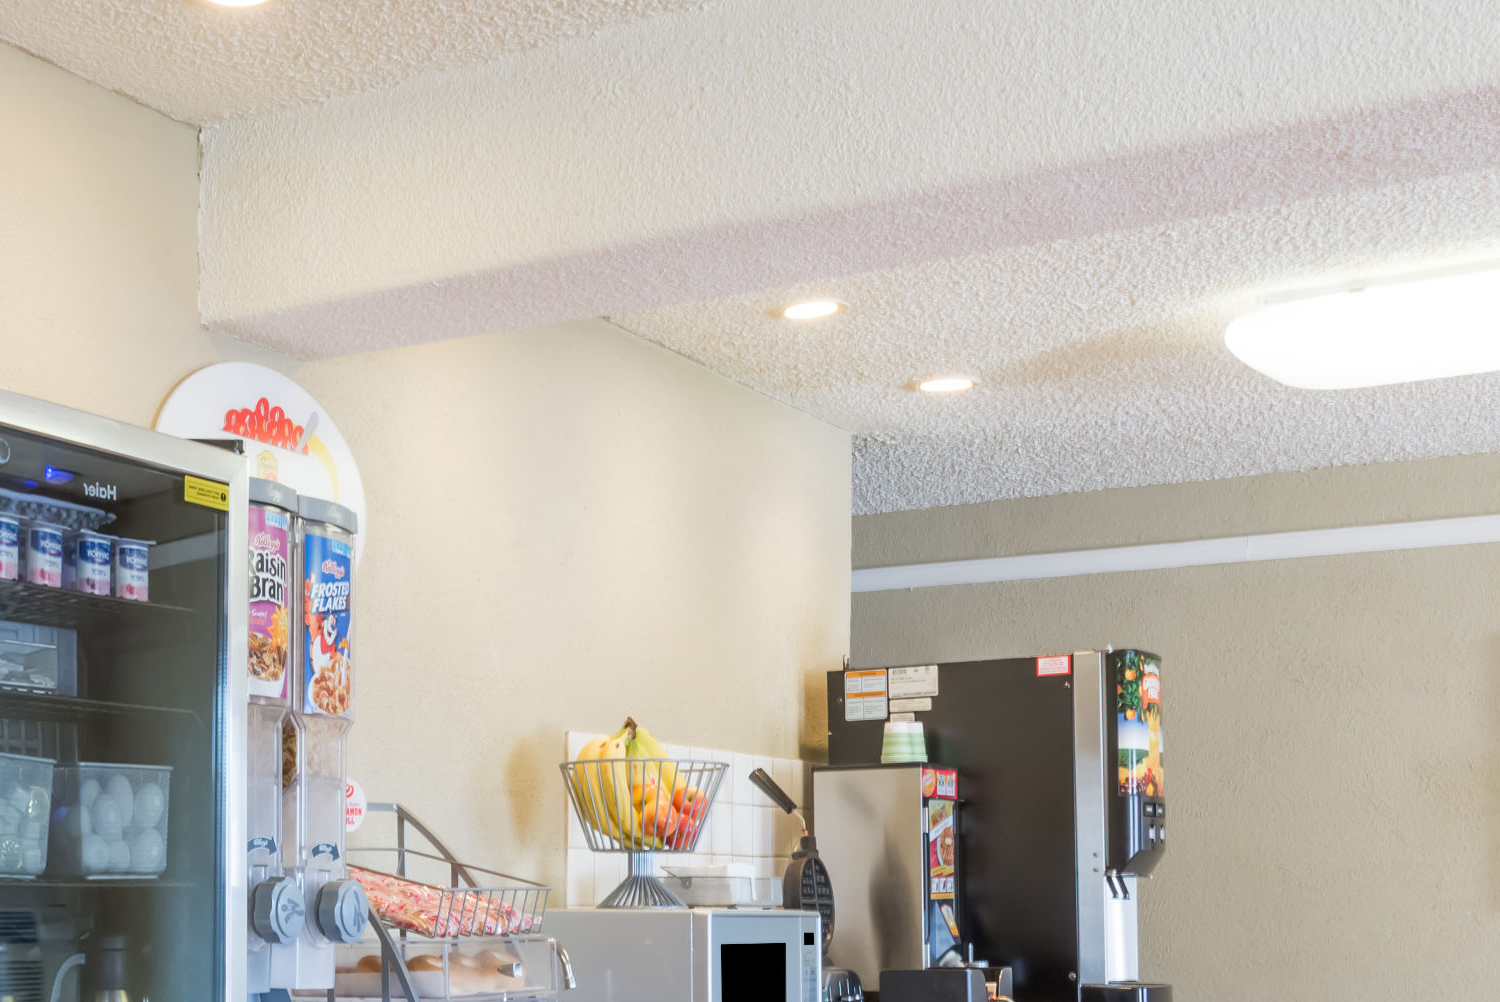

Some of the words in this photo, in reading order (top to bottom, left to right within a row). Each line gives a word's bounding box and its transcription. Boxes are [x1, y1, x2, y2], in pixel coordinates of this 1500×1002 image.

[250, 576, 283, 601] Bran
[312, 582, 349, 598] FROSTED
[312, 596, 347, 611] FLAKES
